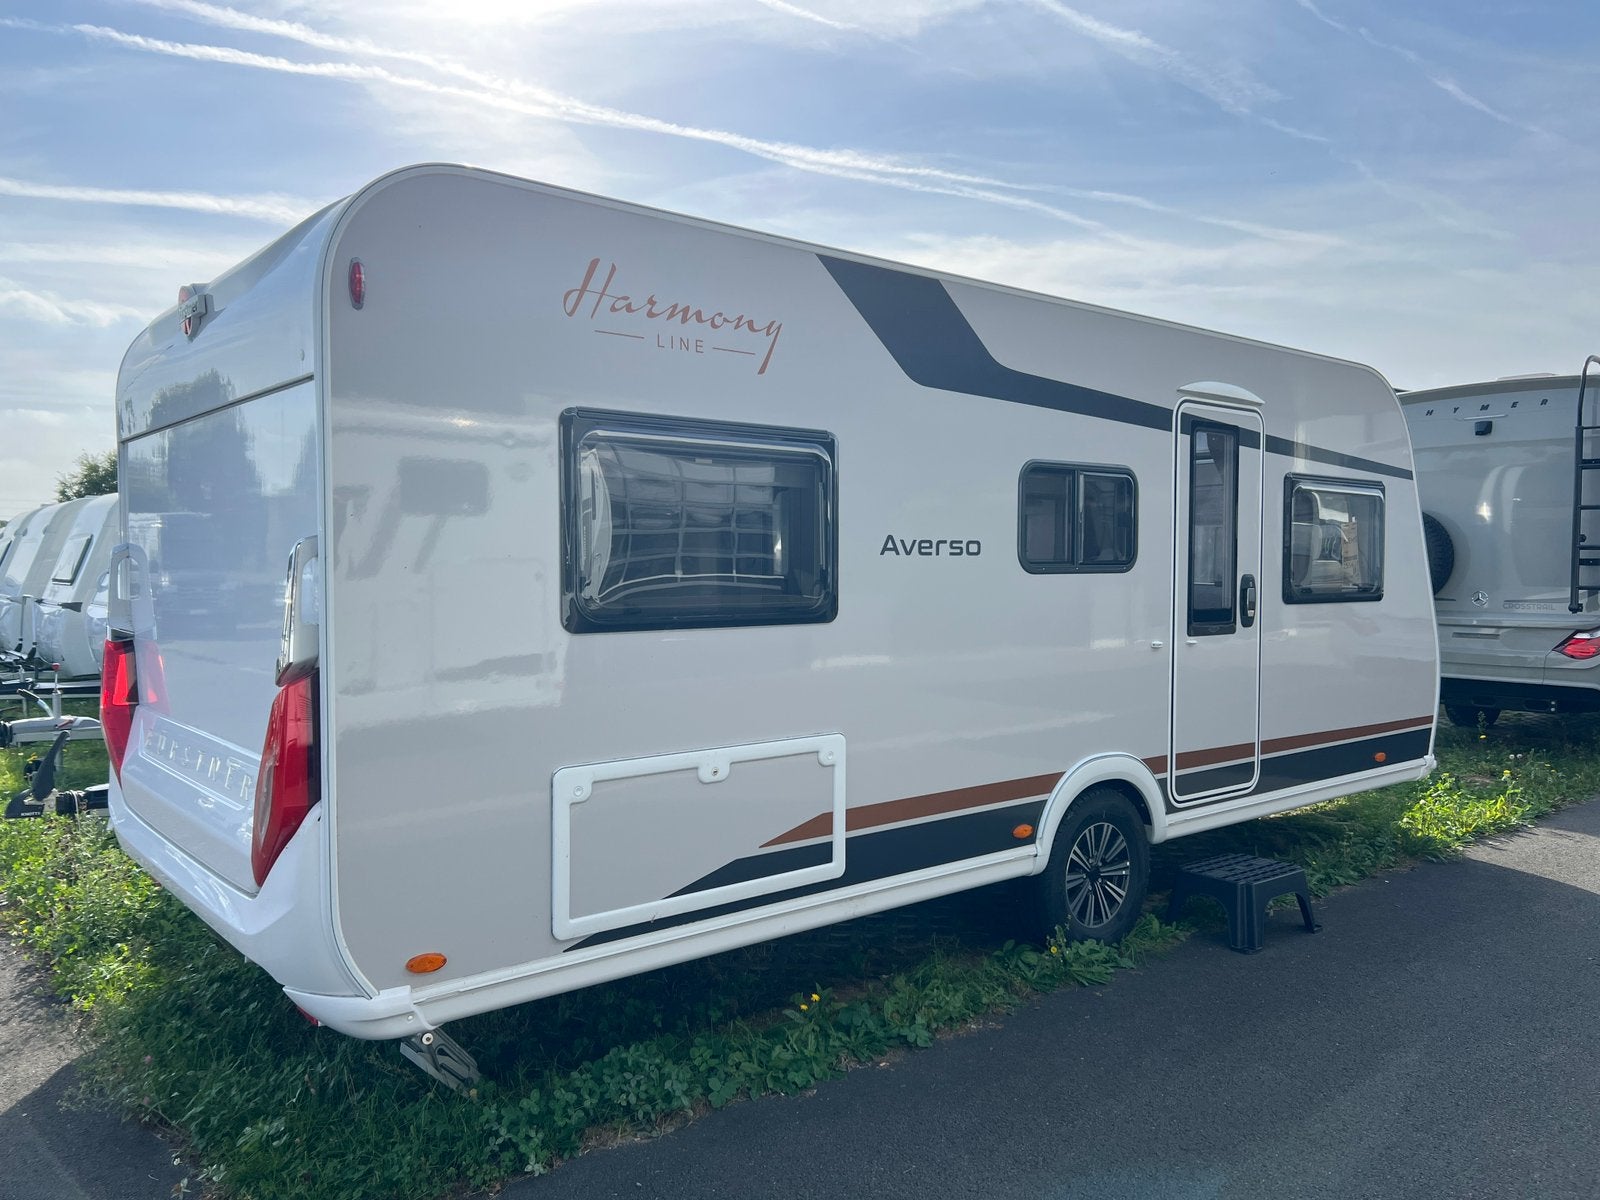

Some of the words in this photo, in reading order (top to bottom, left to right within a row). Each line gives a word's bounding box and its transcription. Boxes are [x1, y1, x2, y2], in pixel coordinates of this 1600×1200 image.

[563, 257, 783, 375] Harmony
[656, 333, 704, 354] LINE
[1425, 398, 1548, 416] HYMER
[880, 534, 981, 556] Averso
[1502, 601, 1556, 611] CROSSTRAIL
